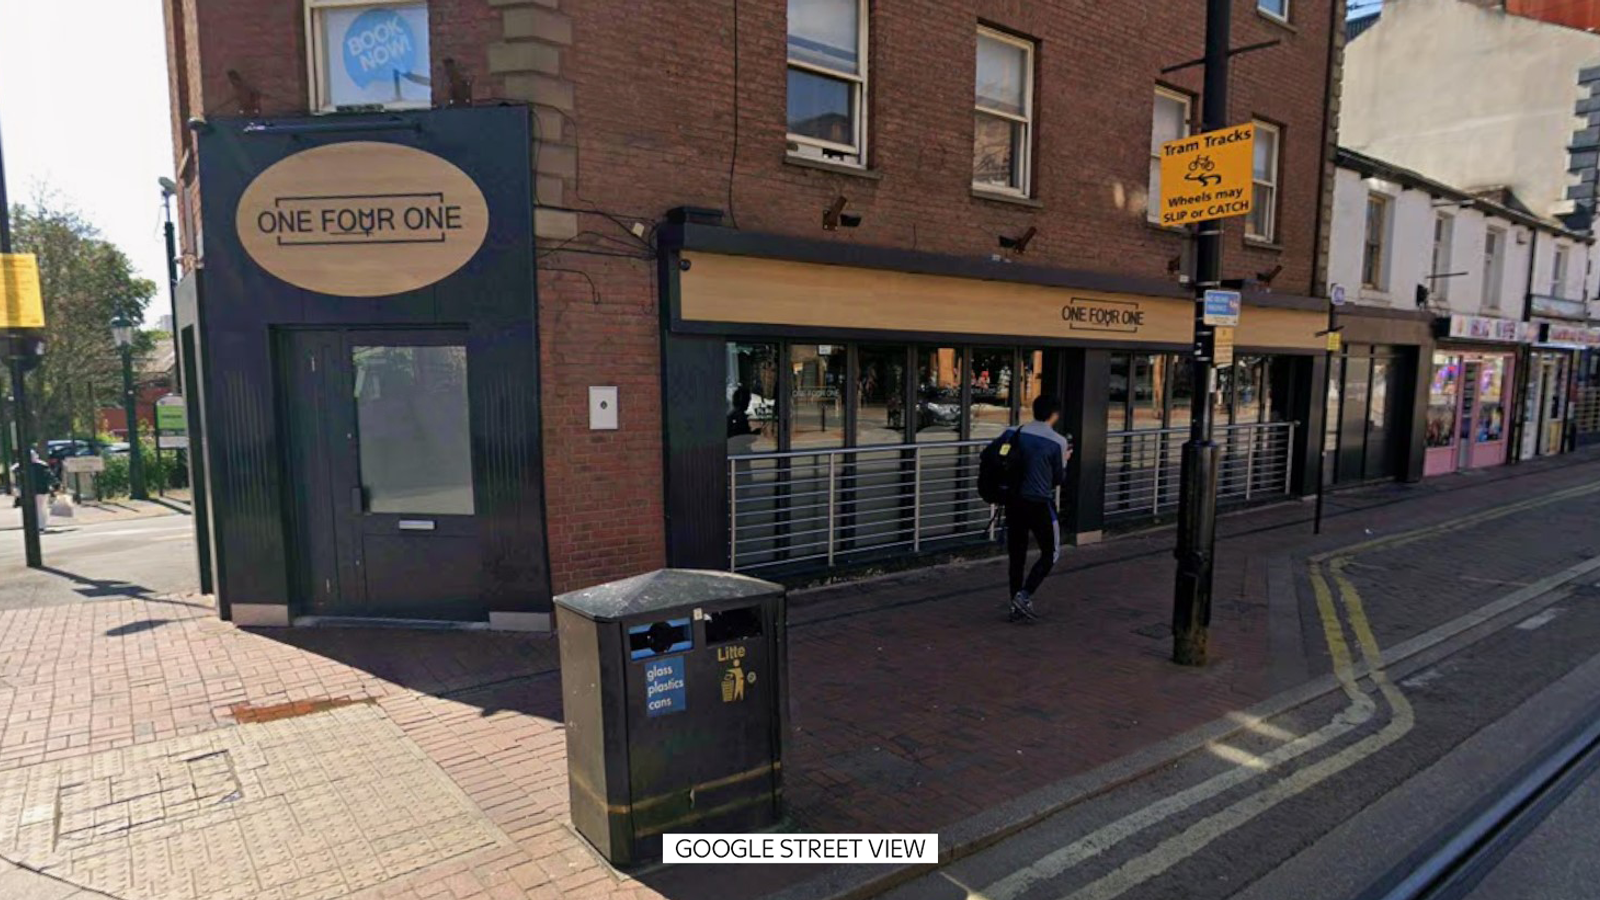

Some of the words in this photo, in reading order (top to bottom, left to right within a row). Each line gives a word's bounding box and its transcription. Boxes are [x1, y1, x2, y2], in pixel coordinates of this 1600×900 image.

[347, 16, 404, 56] BOOK
[1164, 141, 1199, 156] Tram
[1204, 129, 1251, 147] Tracks
[1168, 192, 1212, 207] Wheels
[1215, 188, 1243, 199] may
[257, 210, 312, 233] ONE
[321, 207, 395, 236] FOUR
[403, 206, 462, 230] ONE
[1163, 211, 1188, 223] SLIP
[1190, 209, 1203, 218] or
[1208, 200, 1249, 215] CATCH
[1061, 304, 1087, 322] ONE
[1089, 307, 1120, 326] FOUR
[1122, 309, 1145, 326] ONE
[717, 646, 745, 662] Litte
[647, 665, 673, 682] glass
[647, 679, 684, 698] plastics
[648, 697, 672, 711] cans
